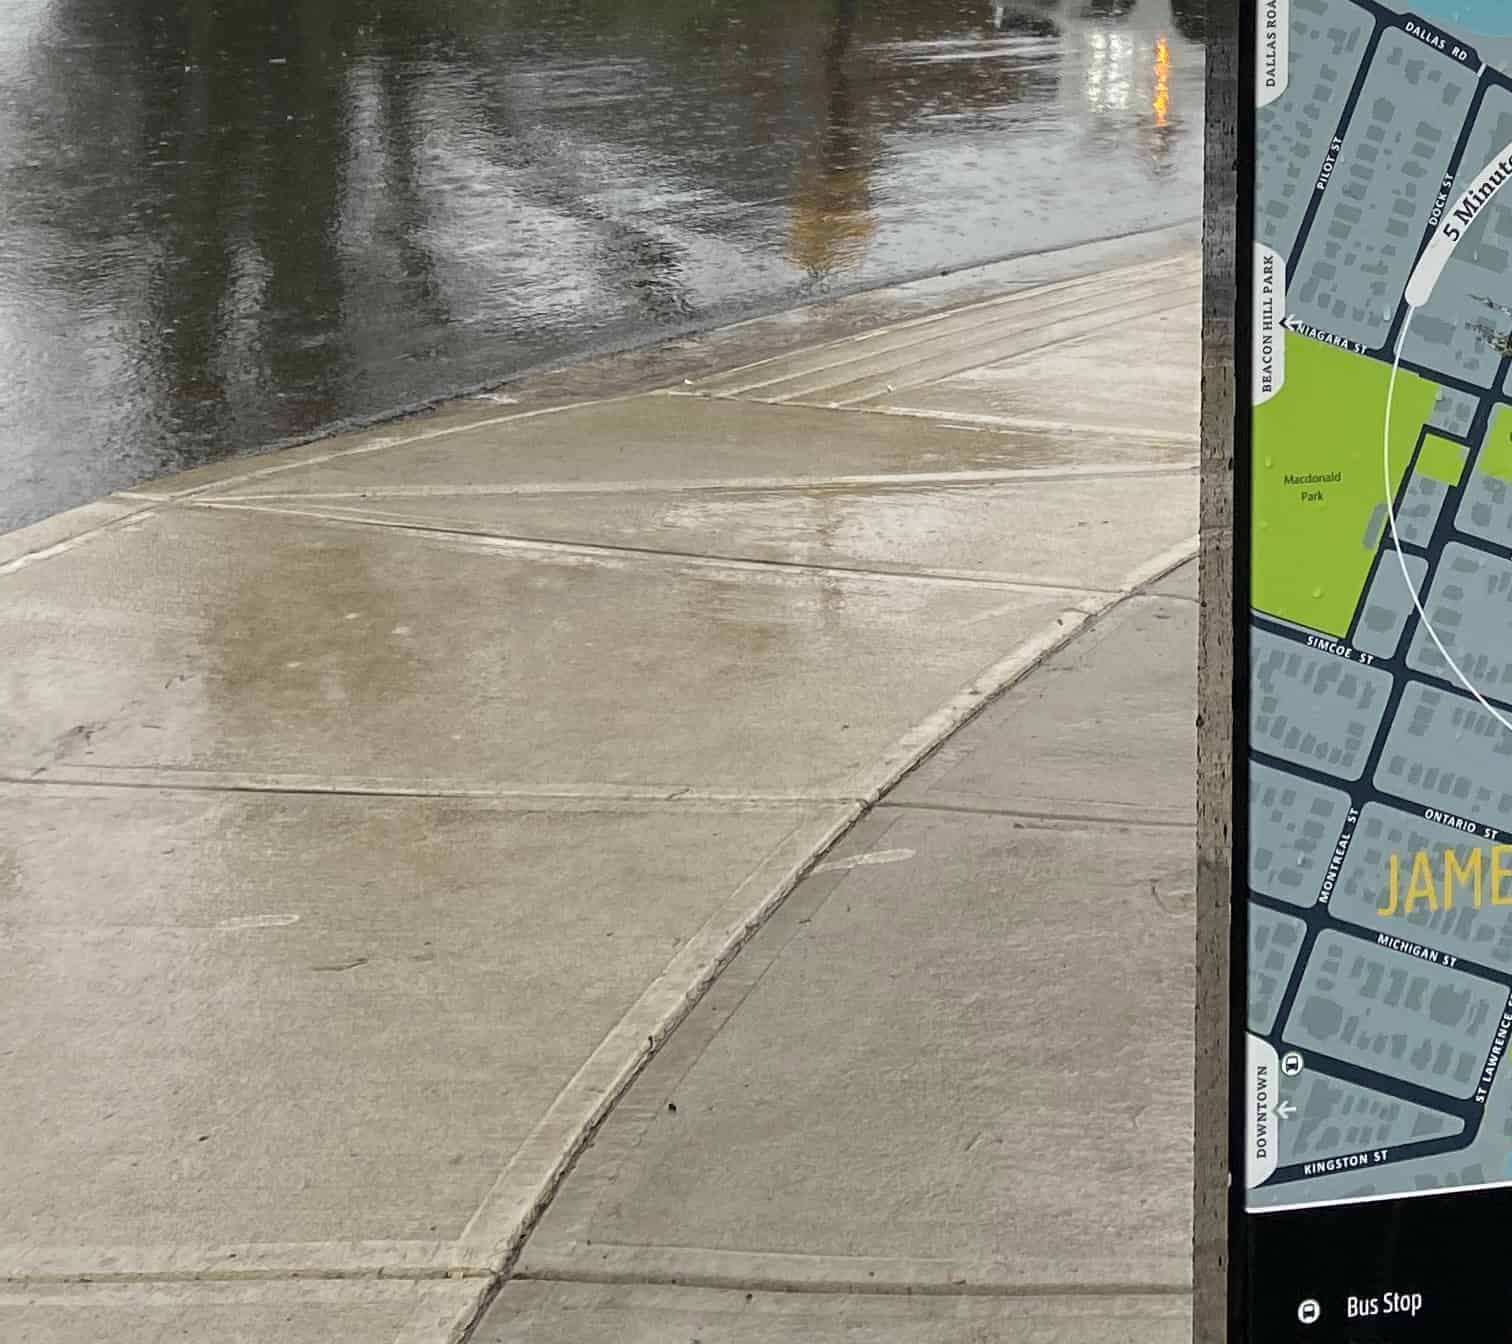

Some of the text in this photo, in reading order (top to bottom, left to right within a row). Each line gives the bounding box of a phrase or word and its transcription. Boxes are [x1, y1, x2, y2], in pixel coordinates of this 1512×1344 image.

[1405, 22, 1467, 61] DALLAS RD
[1266, 32, 1276, 87] DALLAS
[1317, 137, 1343, 190] PILOT ST
[1429, 174, 1453, 226] DOCK ST
[1443, 223, 1460, 242] 5
[1262, 255, 1273, 393] BEACON HILL PARK
[1296, 323, 1369, 355] NIAGARA ST
[1284, 472, 1341, 486] Macdonald
[1301, 490, 1323, 502] Park
[1306, 635, 1375, 665] SIMCOE ST
[1424, 809, 1500, 840] ONTARIO ST
[1319, 808, 1359, 903] MONTREAL ST
[1377, 934, 1457, 968] MICHIGAN ST
[1475, 1086, 1487, 1103] ST
[1481, 1009, 1512, 1083] LAWRENCE
[1257, 1065, 1267, 1159] DOWNTOWN
[1304, 1150, 1388, 1175] KINGSTON ST
[1347, 1292, 1422, 1318] Bus Stop
